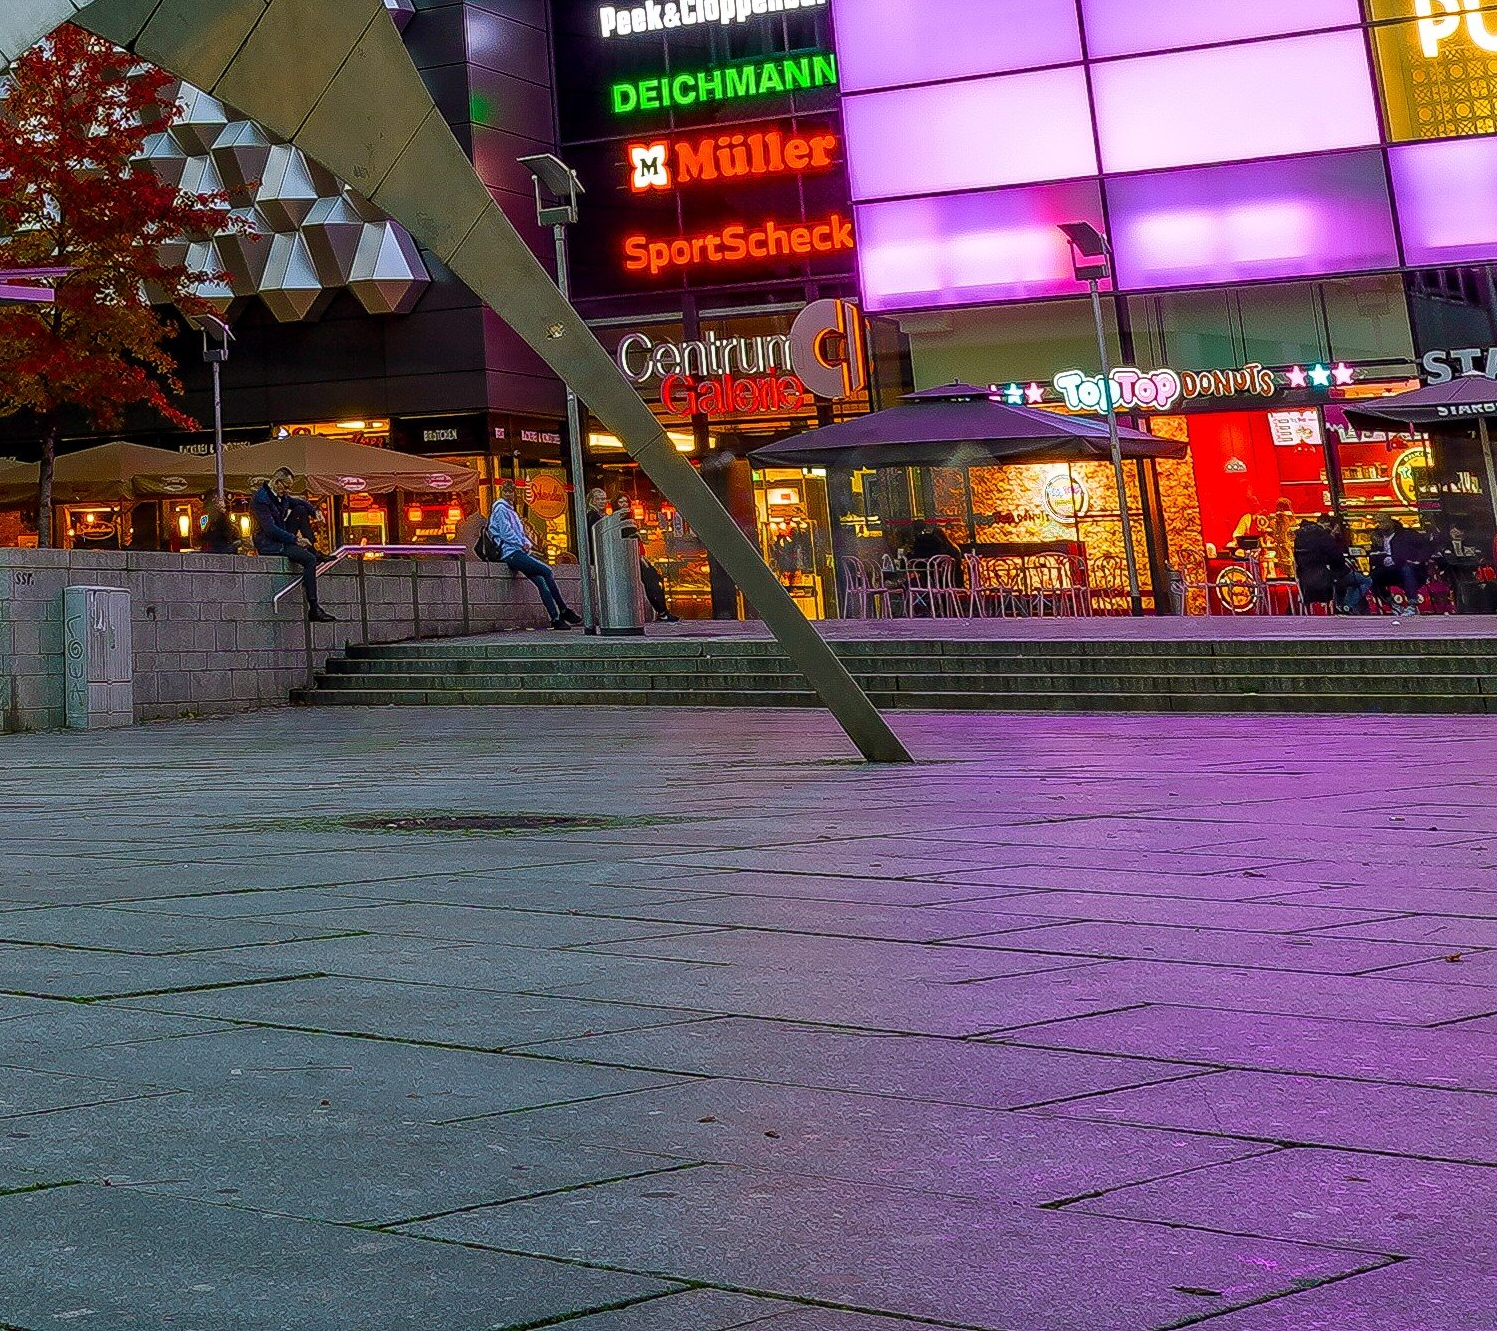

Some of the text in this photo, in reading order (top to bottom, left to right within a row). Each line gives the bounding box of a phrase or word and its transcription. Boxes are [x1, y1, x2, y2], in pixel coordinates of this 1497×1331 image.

[611, 52, 838, 114] DEICHMANN
[676, 133, 837, 184] Müller
[623, 215, 857, 276] SportScheck
[661, 366, 805, 418] Galerie
